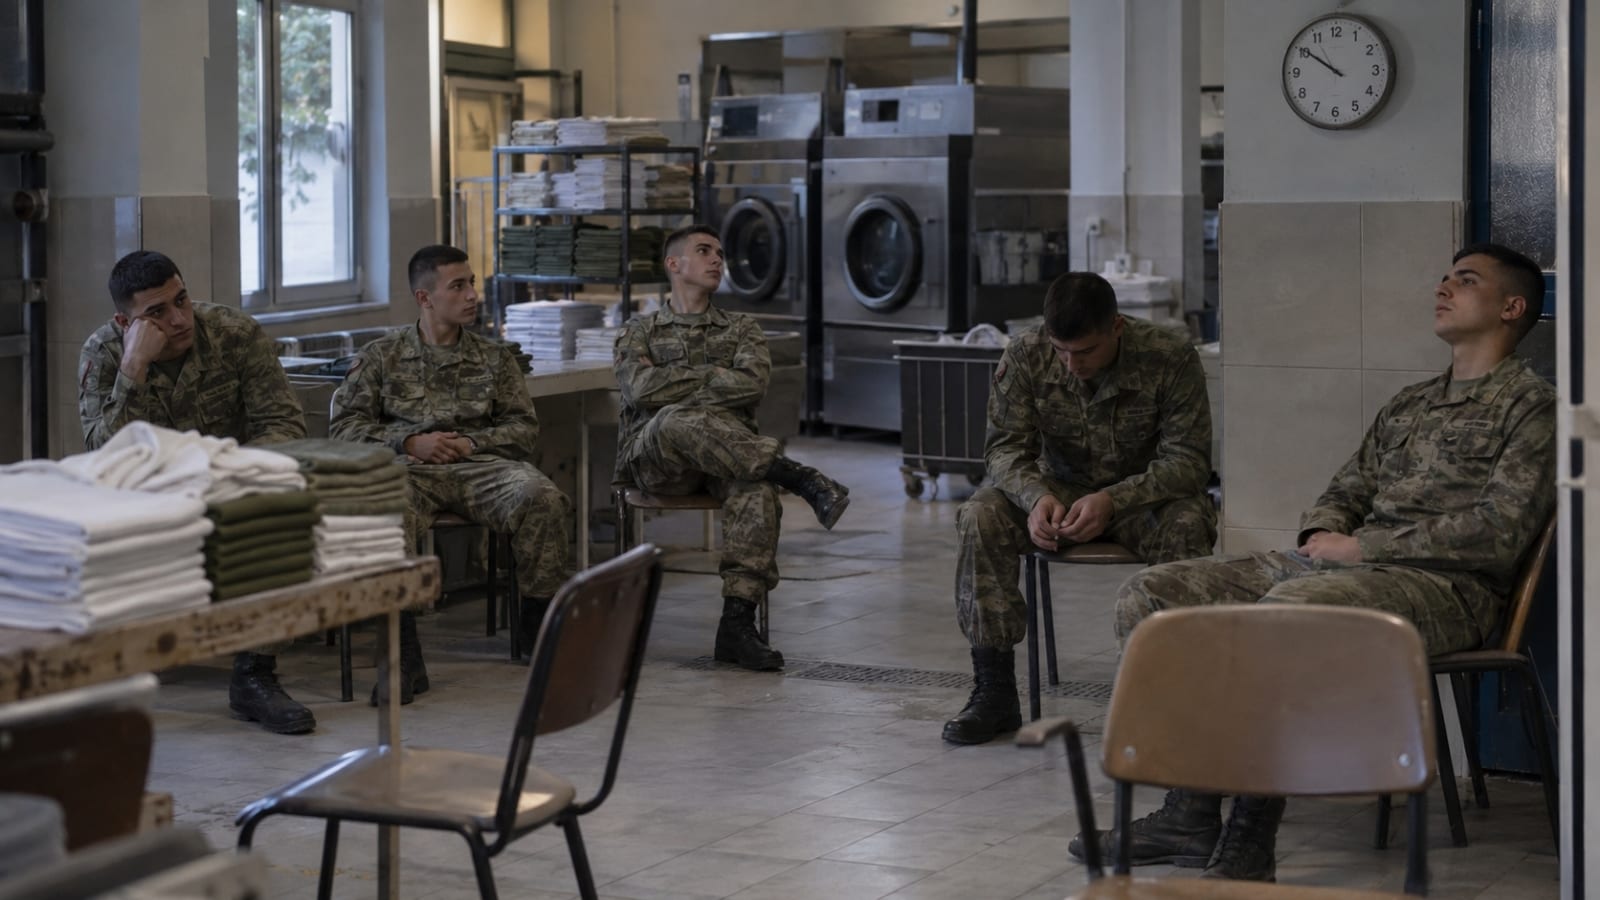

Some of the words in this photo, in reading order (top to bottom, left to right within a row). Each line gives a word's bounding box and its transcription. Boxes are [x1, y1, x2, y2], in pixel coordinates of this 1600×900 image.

[1313, 32, 1322, 43] 11
[1330, 26, 1342, 38] 12
[1353, 30, 1358, 42] 1
[1299, 47, 1310, 58] 10
[1366, 44, 1374, 55] 2
[1292, 67, 1301, 78] 9
[1372, 64, 1380, 76] 3
[1298, 87, 1306, 98] 8
[1365, 85, 1373, 96] 4
[1313, 101, 1320, 112] 7
[1331, 106, 1339, 117] 6
[1352, 100, 1359, 112] 5
